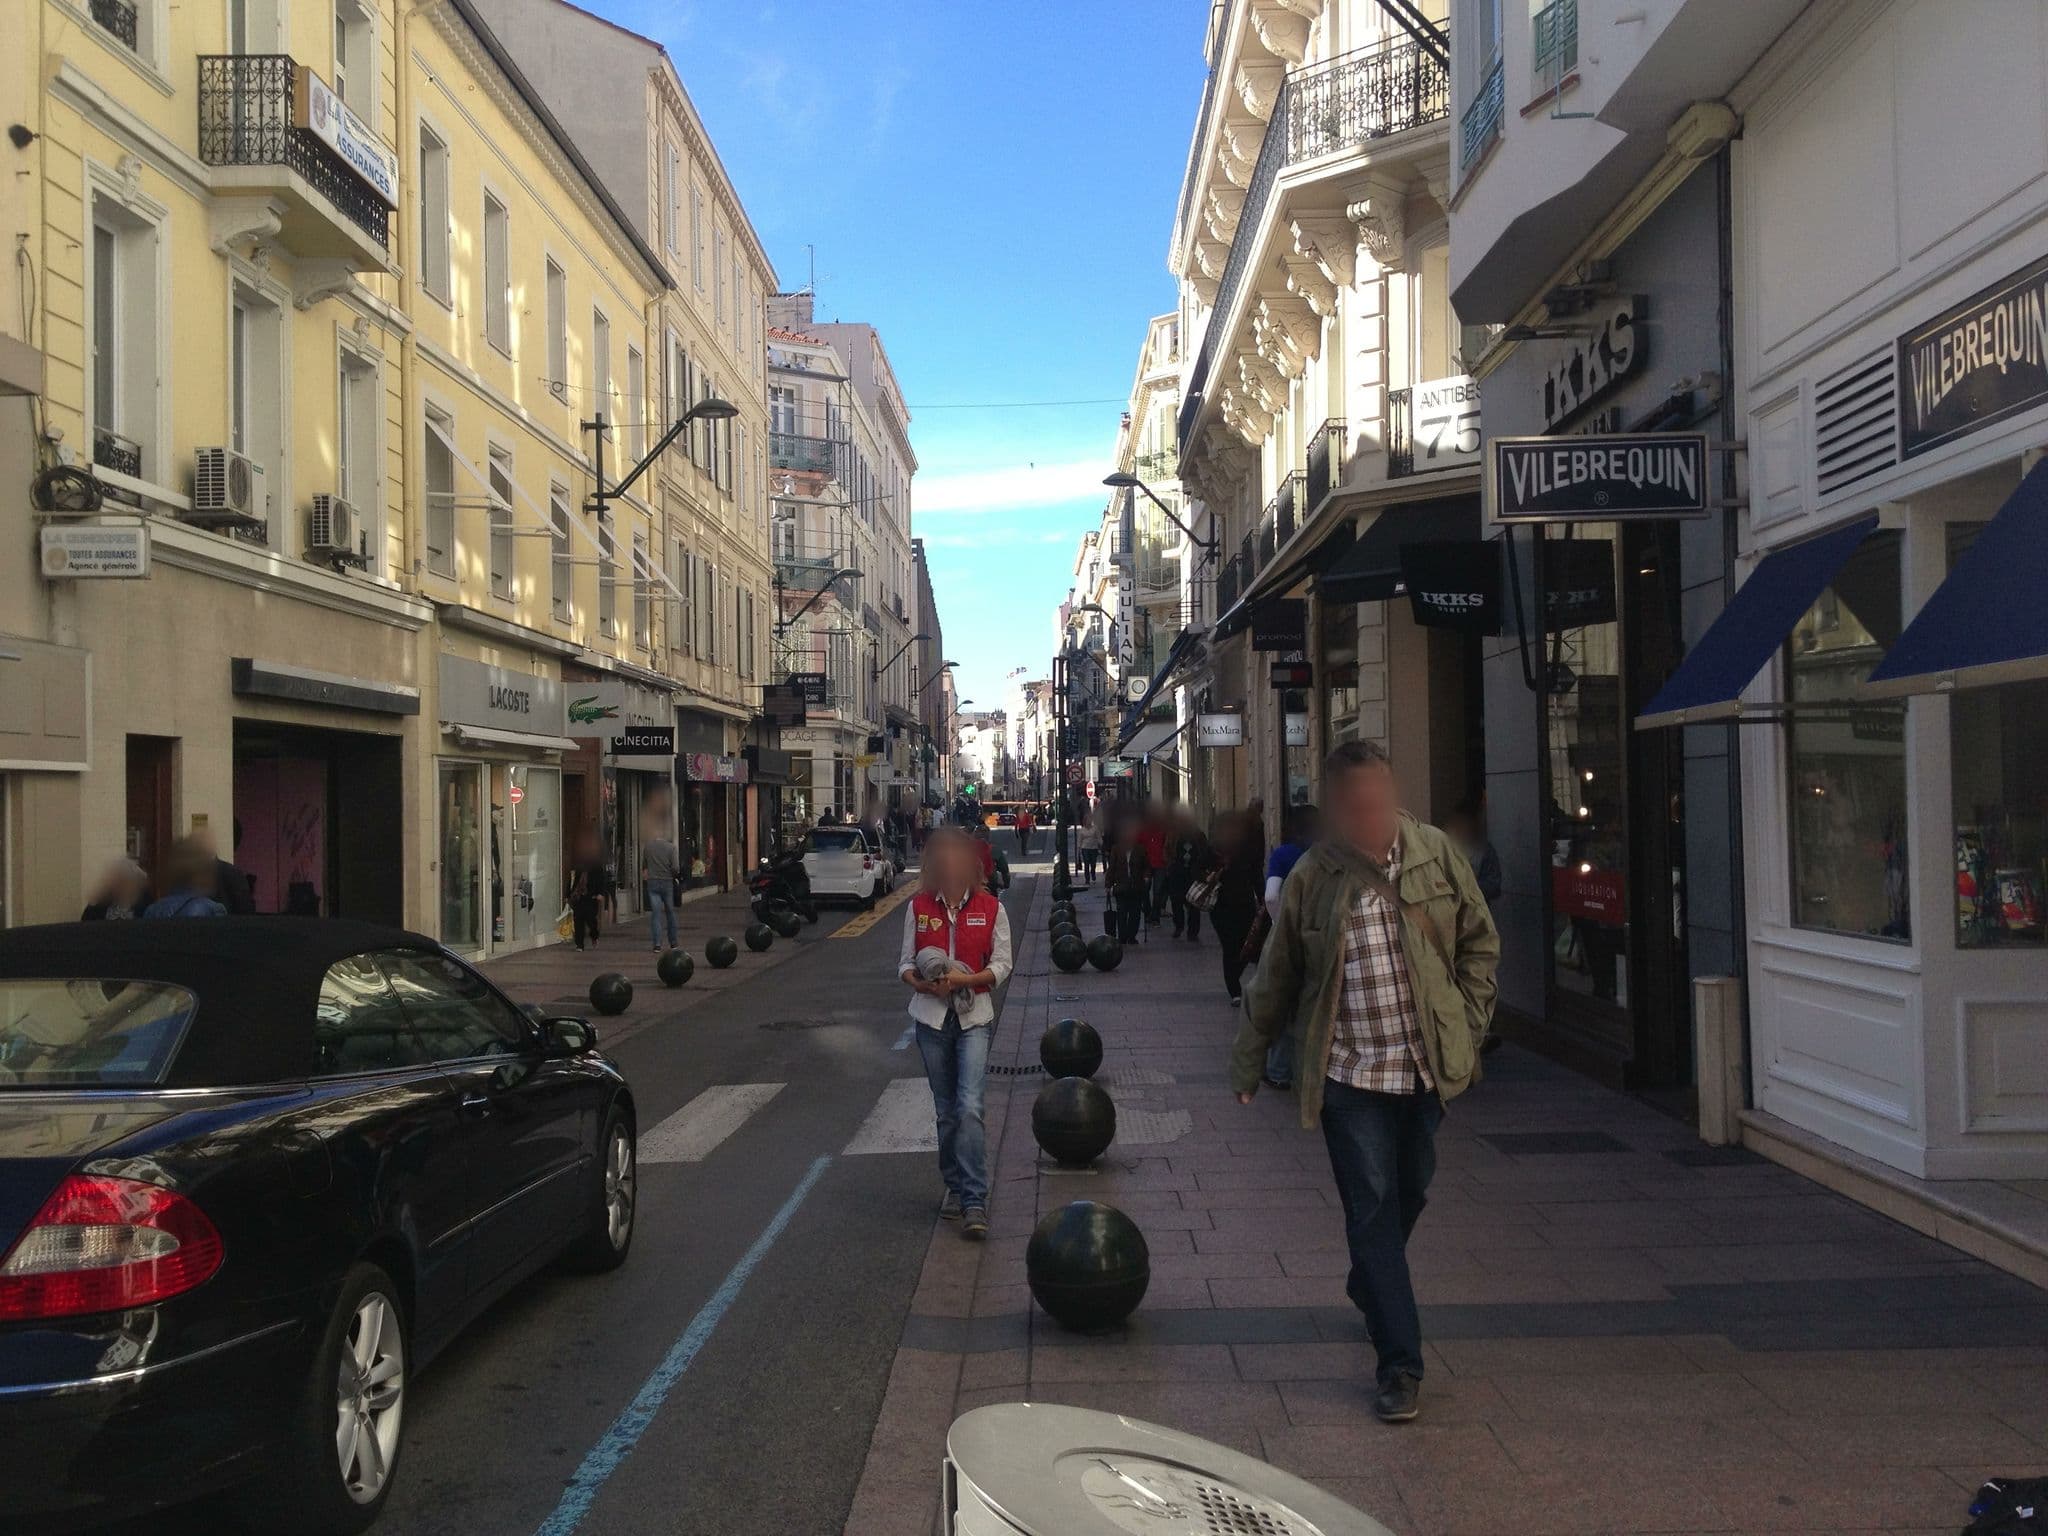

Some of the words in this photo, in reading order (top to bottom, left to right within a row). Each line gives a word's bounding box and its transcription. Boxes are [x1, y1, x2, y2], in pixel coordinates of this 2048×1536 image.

[336, 133, 390, 194] ASSURANCES
[1544, 300, 1635, 424] IKKS
[1911, 282, 2048, 431] VILEBREQUIN
[1420, 411, 1481, 459] 75
[1507, 447, 1696, 505] VILEBREQUIN
[68, 562, 98, 572] Agence
[102, 562, 136, 572] générale
[69, 550, 92, 559] TOUTES
[95, 550, 136, 559] ASSURANCES
[1420, 592, 1483, 607] IKKS
[1121, 581, 1132, 664] JULIAN
[490, 686, 530, 713] LACOSTE
[615, 736, 670, 747] CINECITTA
[1202, 725, 1240, 735] MaxMara
